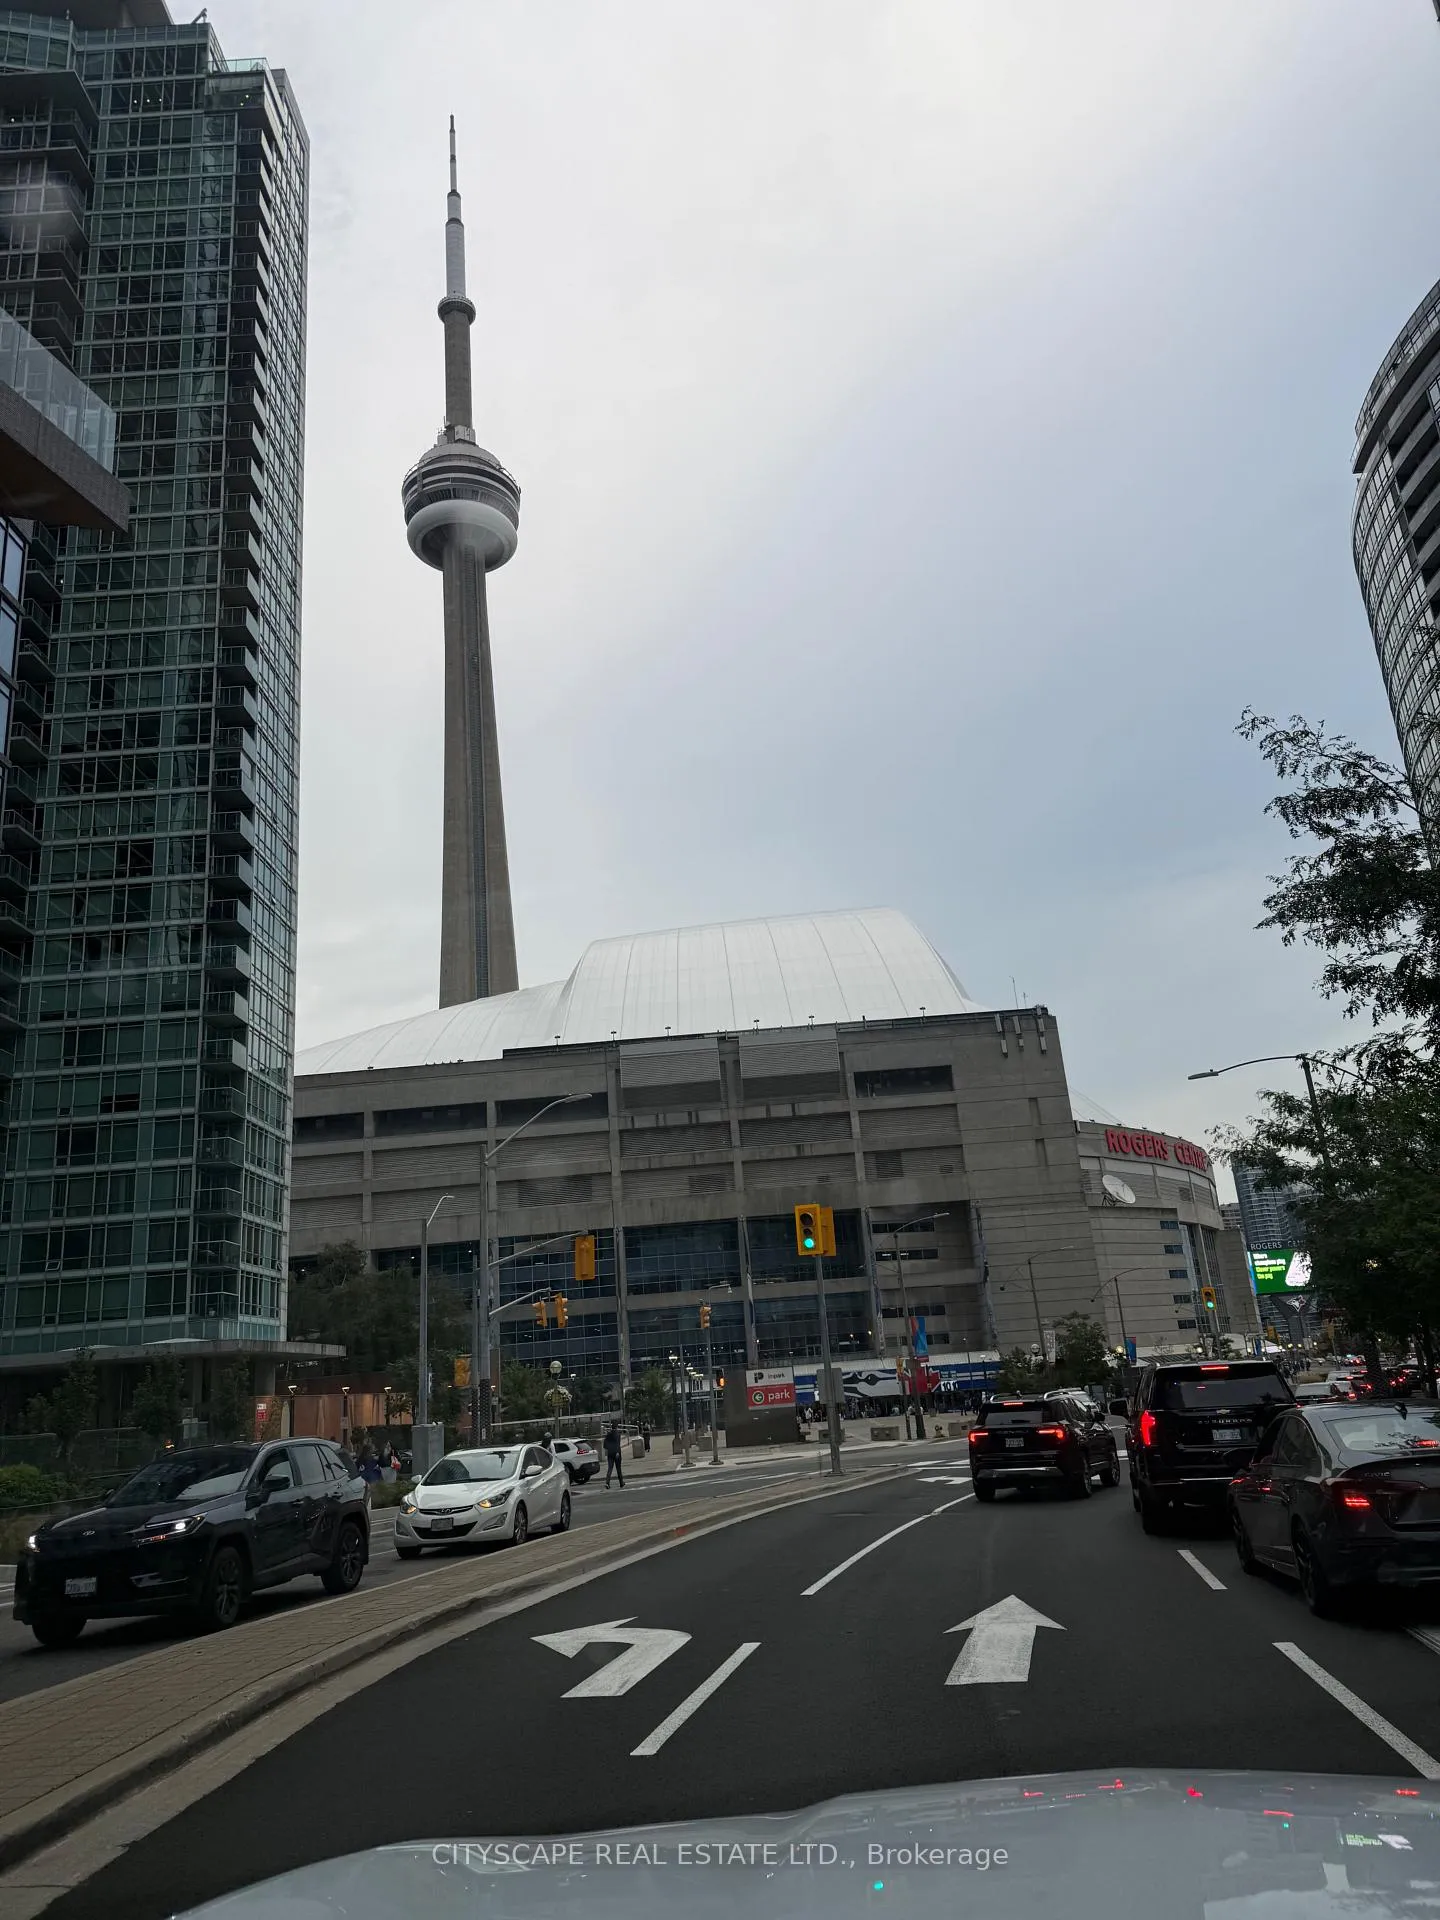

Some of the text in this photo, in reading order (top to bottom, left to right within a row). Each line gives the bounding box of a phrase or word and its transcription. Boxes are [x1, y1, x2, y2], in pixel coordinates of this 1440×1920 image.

[1105, 1128, 1170, 1161] ROGERS
[1251, 1242, 1282, 1250] ROGERS
[768, 1389, 791, 1403] park
